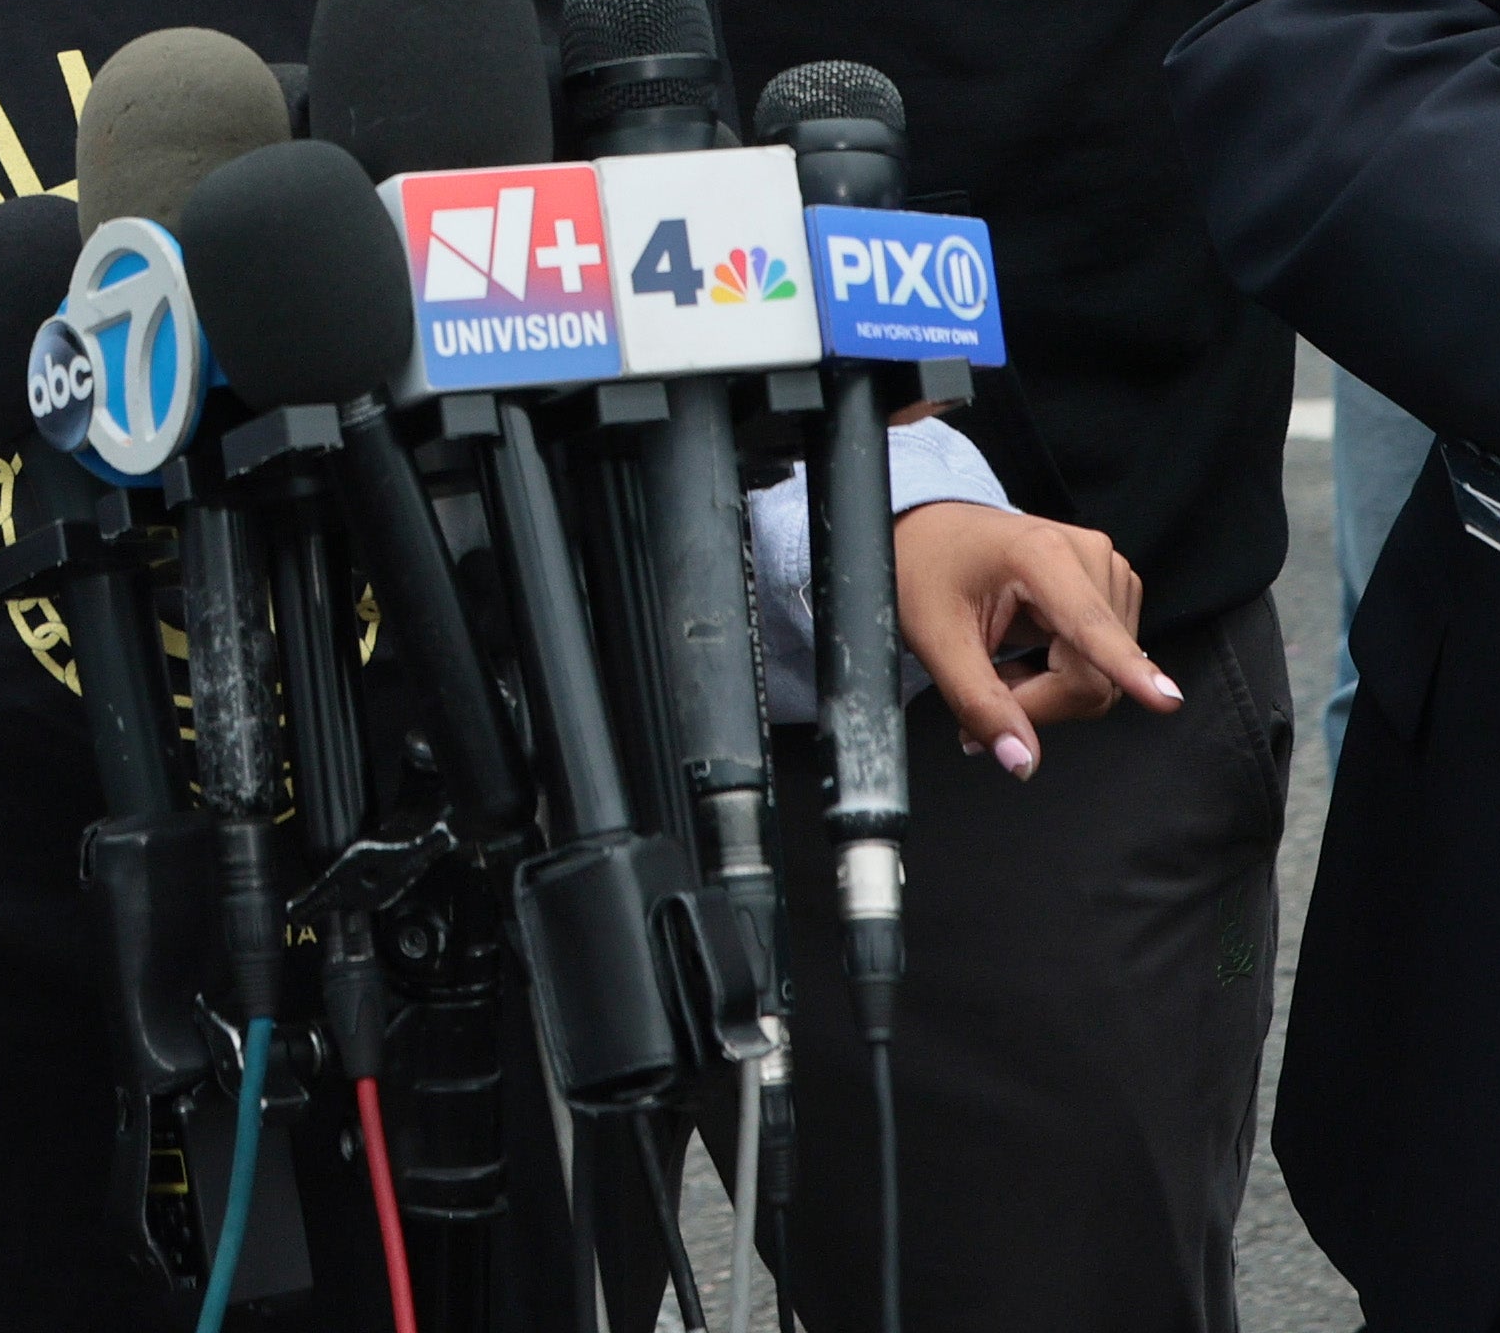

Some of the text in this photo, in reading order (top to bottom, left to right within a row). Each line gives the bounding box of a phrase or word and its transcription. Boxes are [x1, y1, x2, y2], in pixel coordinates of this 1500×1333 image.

[629, 218, 705, 307] 4
[432, 309, 608, 358] UNIVISION
[856, 321, 882, 339] NEW
[921, 326, 951, 345] VERY
[951, 328, 980, 347] OWN
[28, 352, 94, 418] abc
